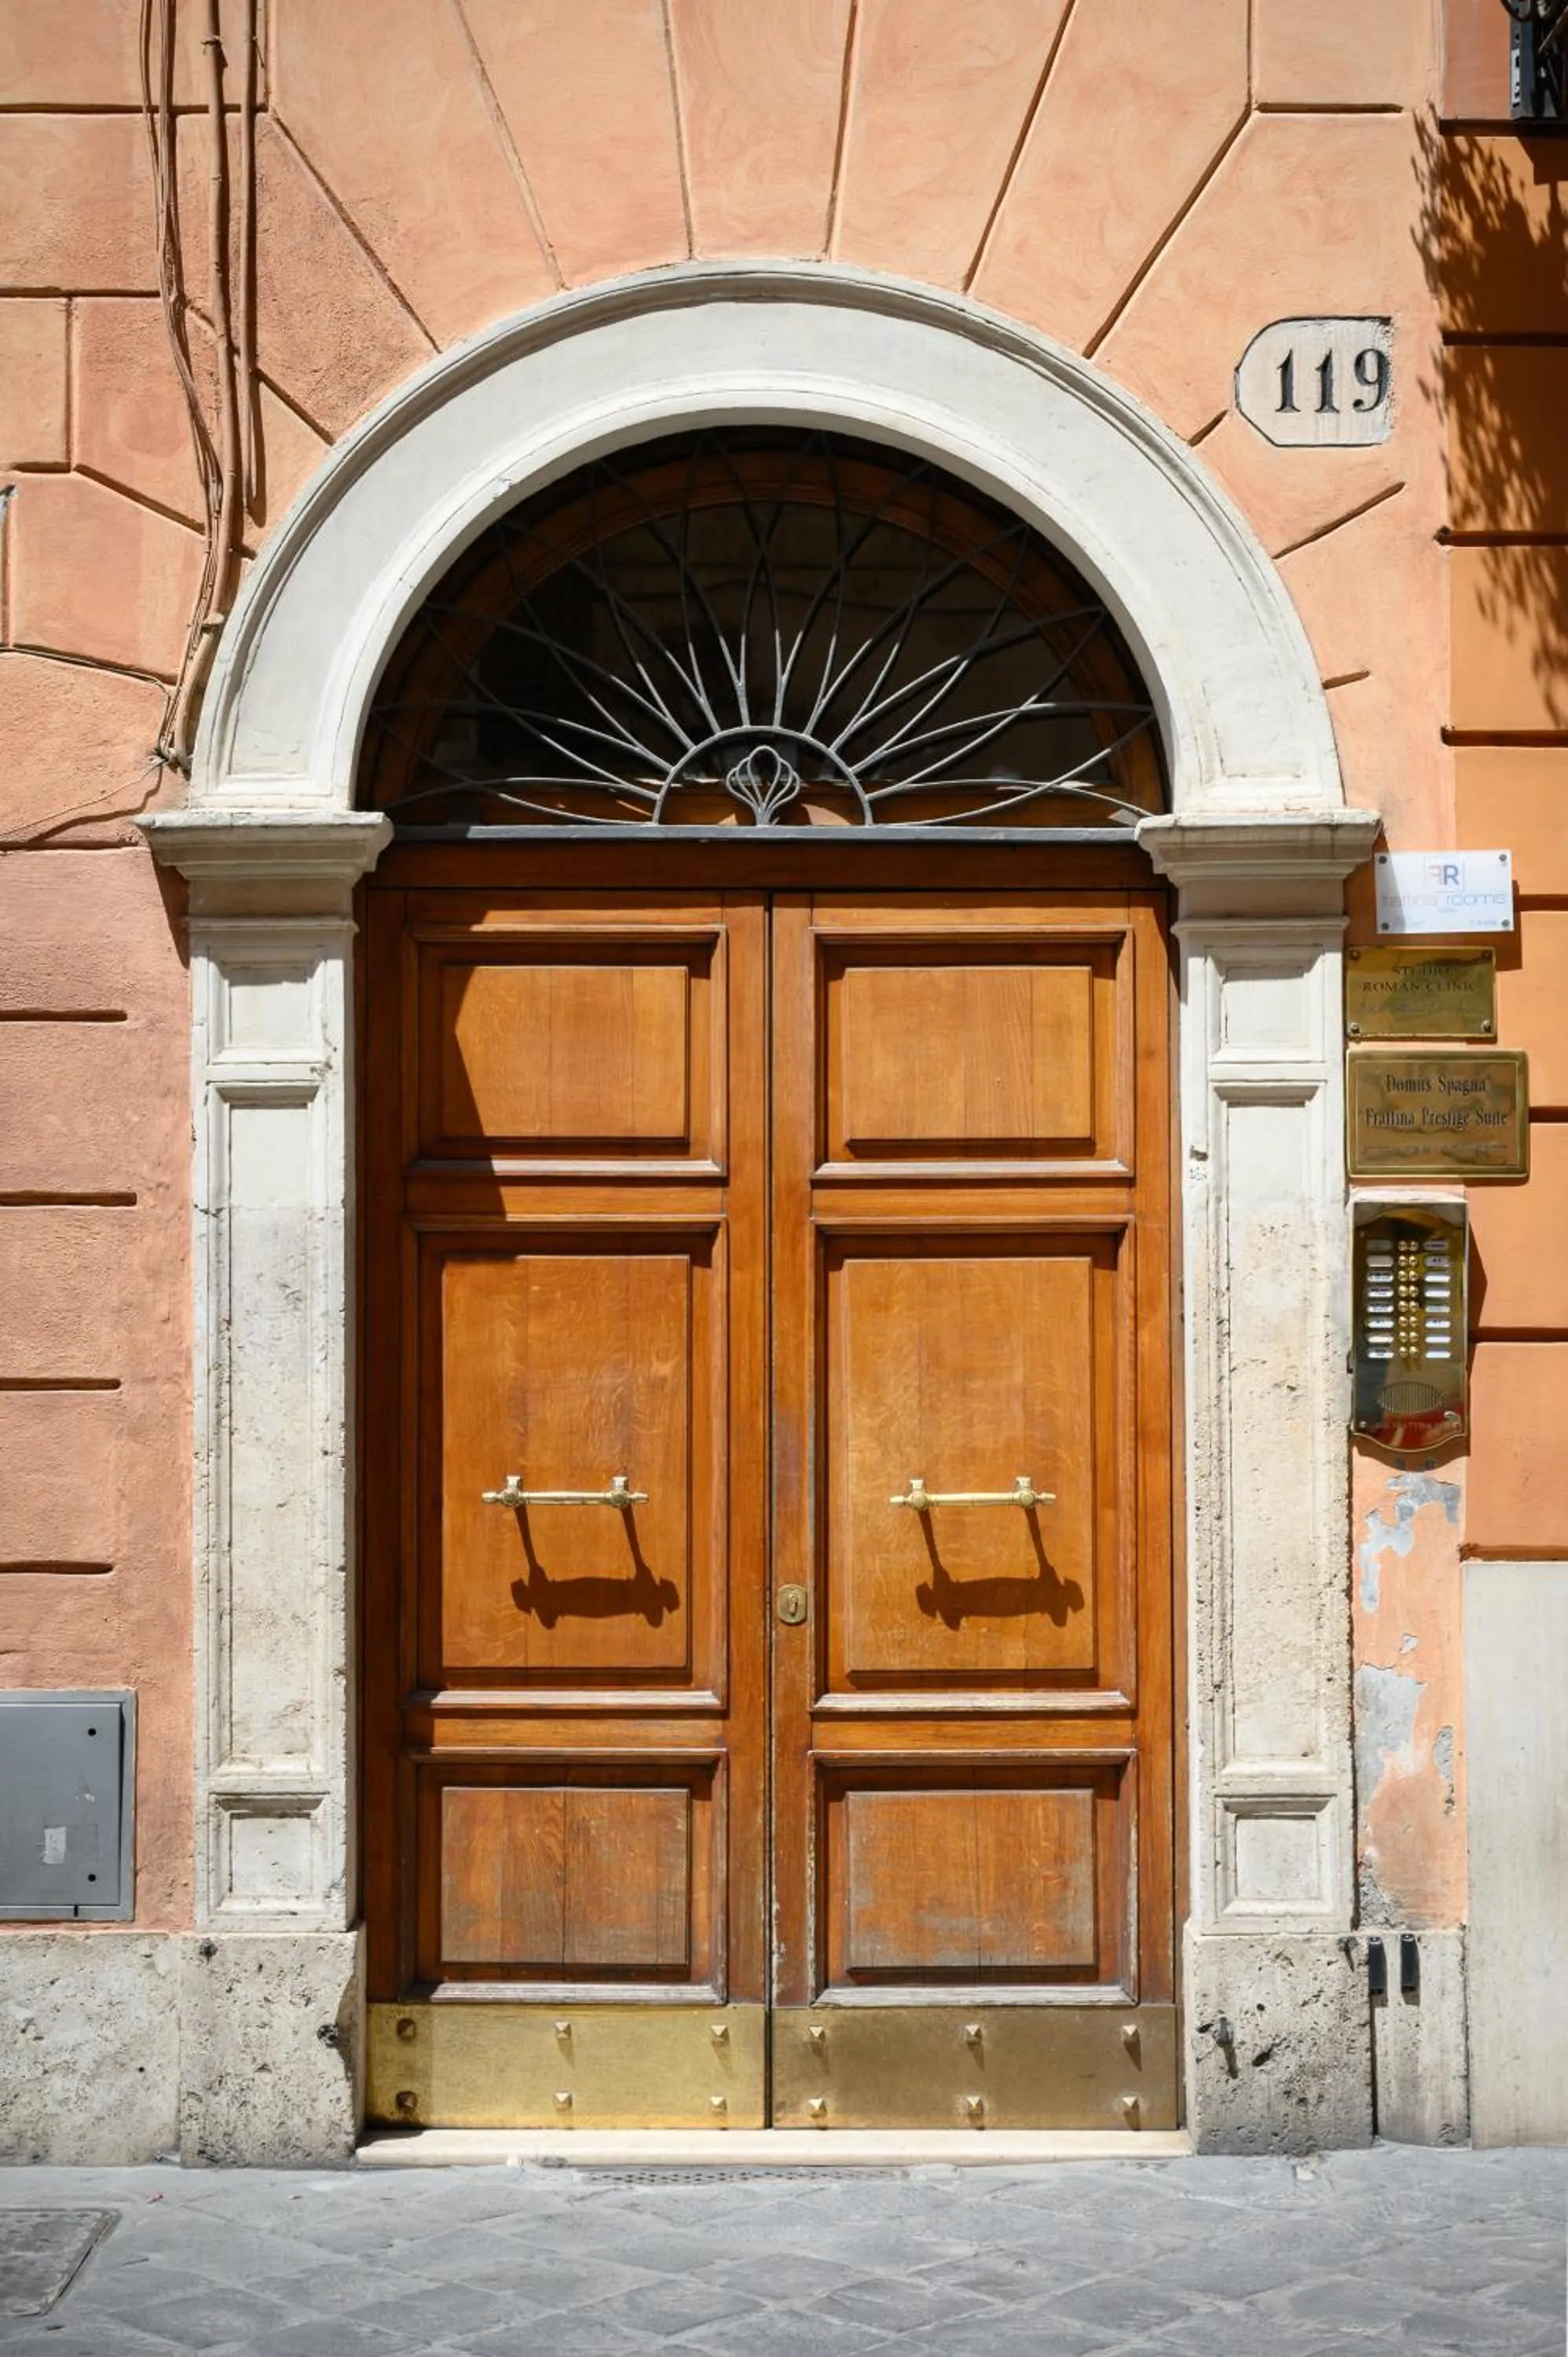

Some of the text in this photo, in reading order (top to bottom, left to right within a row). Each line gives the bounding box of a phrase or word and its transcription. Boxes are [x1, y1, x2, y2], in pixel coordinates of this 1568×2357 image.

[1275, 348, 1390, 413] 119
[1362, 981, 1420, 992] ROMAN
[1387, 1074, 1486, 1095] Domus Spagna
[1422, 1106, 1469, 1129] Prestige
